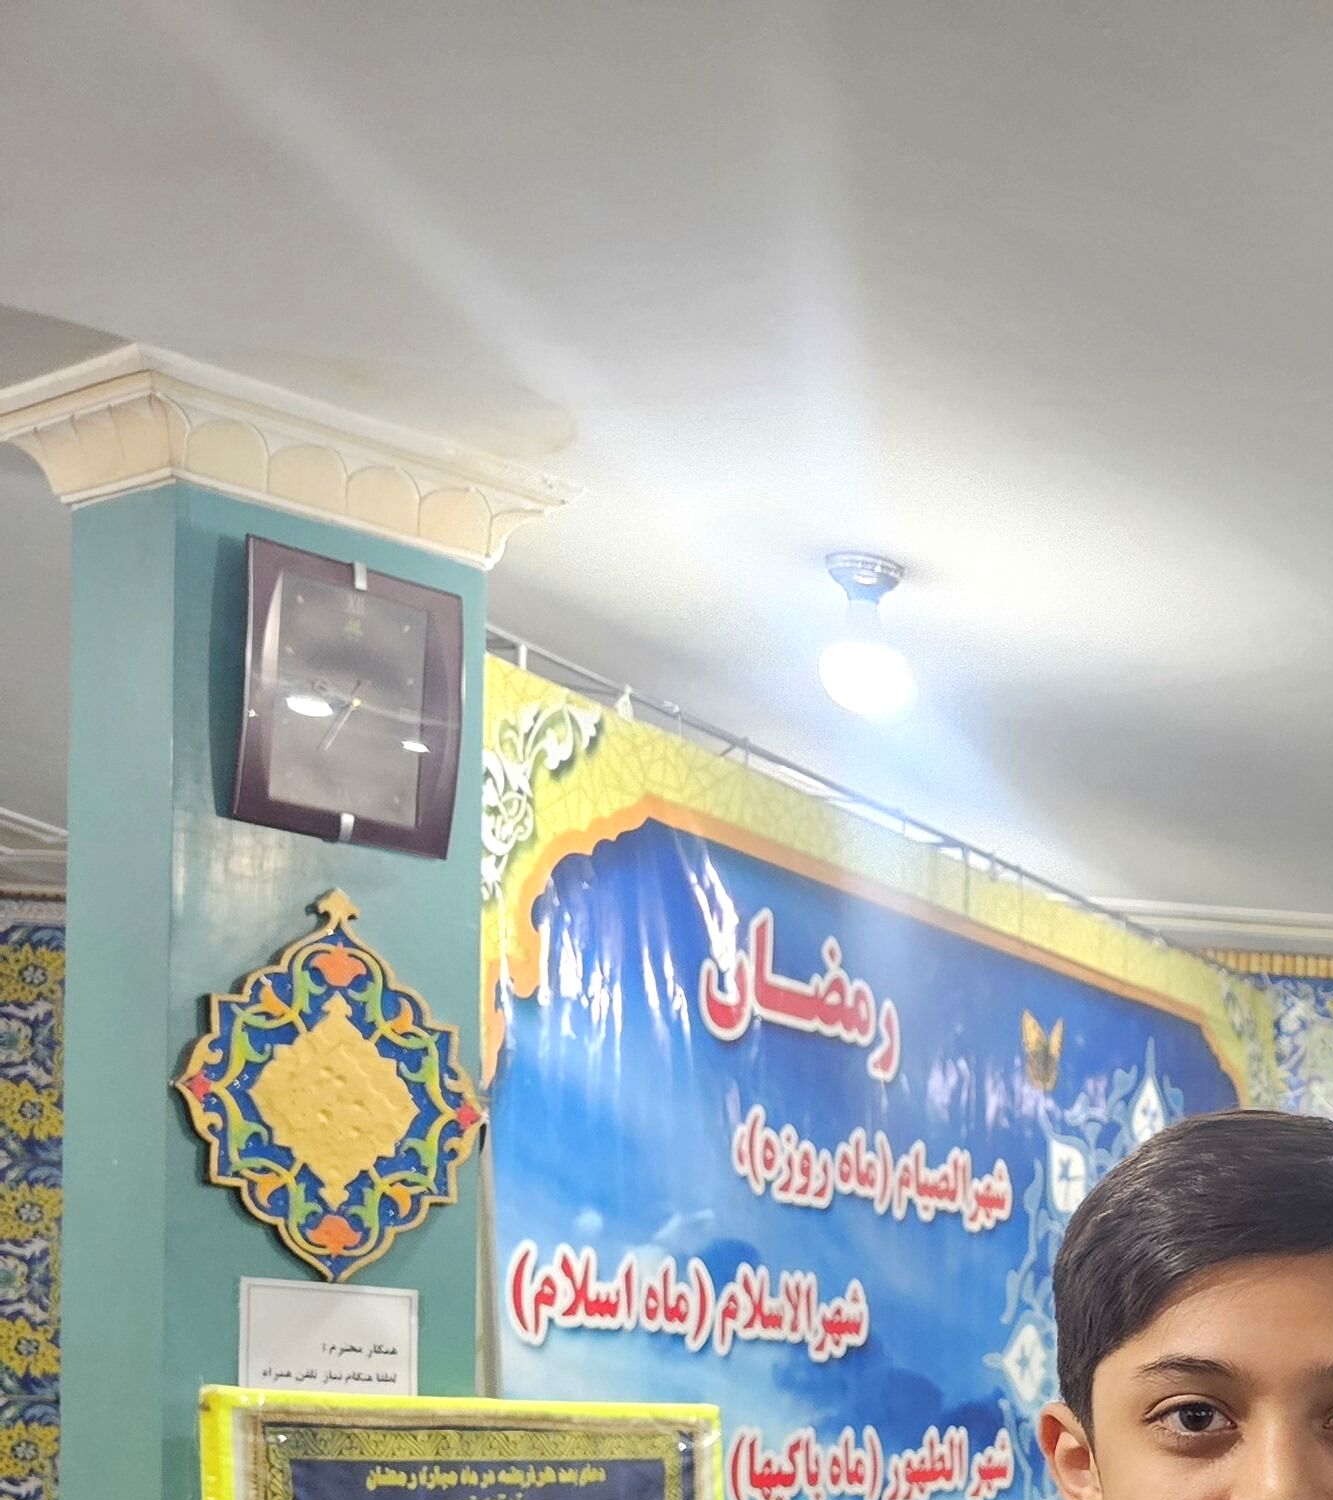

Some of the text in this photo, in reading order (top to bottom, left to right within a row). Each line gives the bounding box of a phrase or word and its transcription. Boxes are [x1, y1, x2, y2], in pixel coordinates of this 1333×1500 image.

[702, 911, 898, 1081] رمضان
[964, 1160, 1011, 1232] شهر
[812, 1280, 868, 1361] شهر
